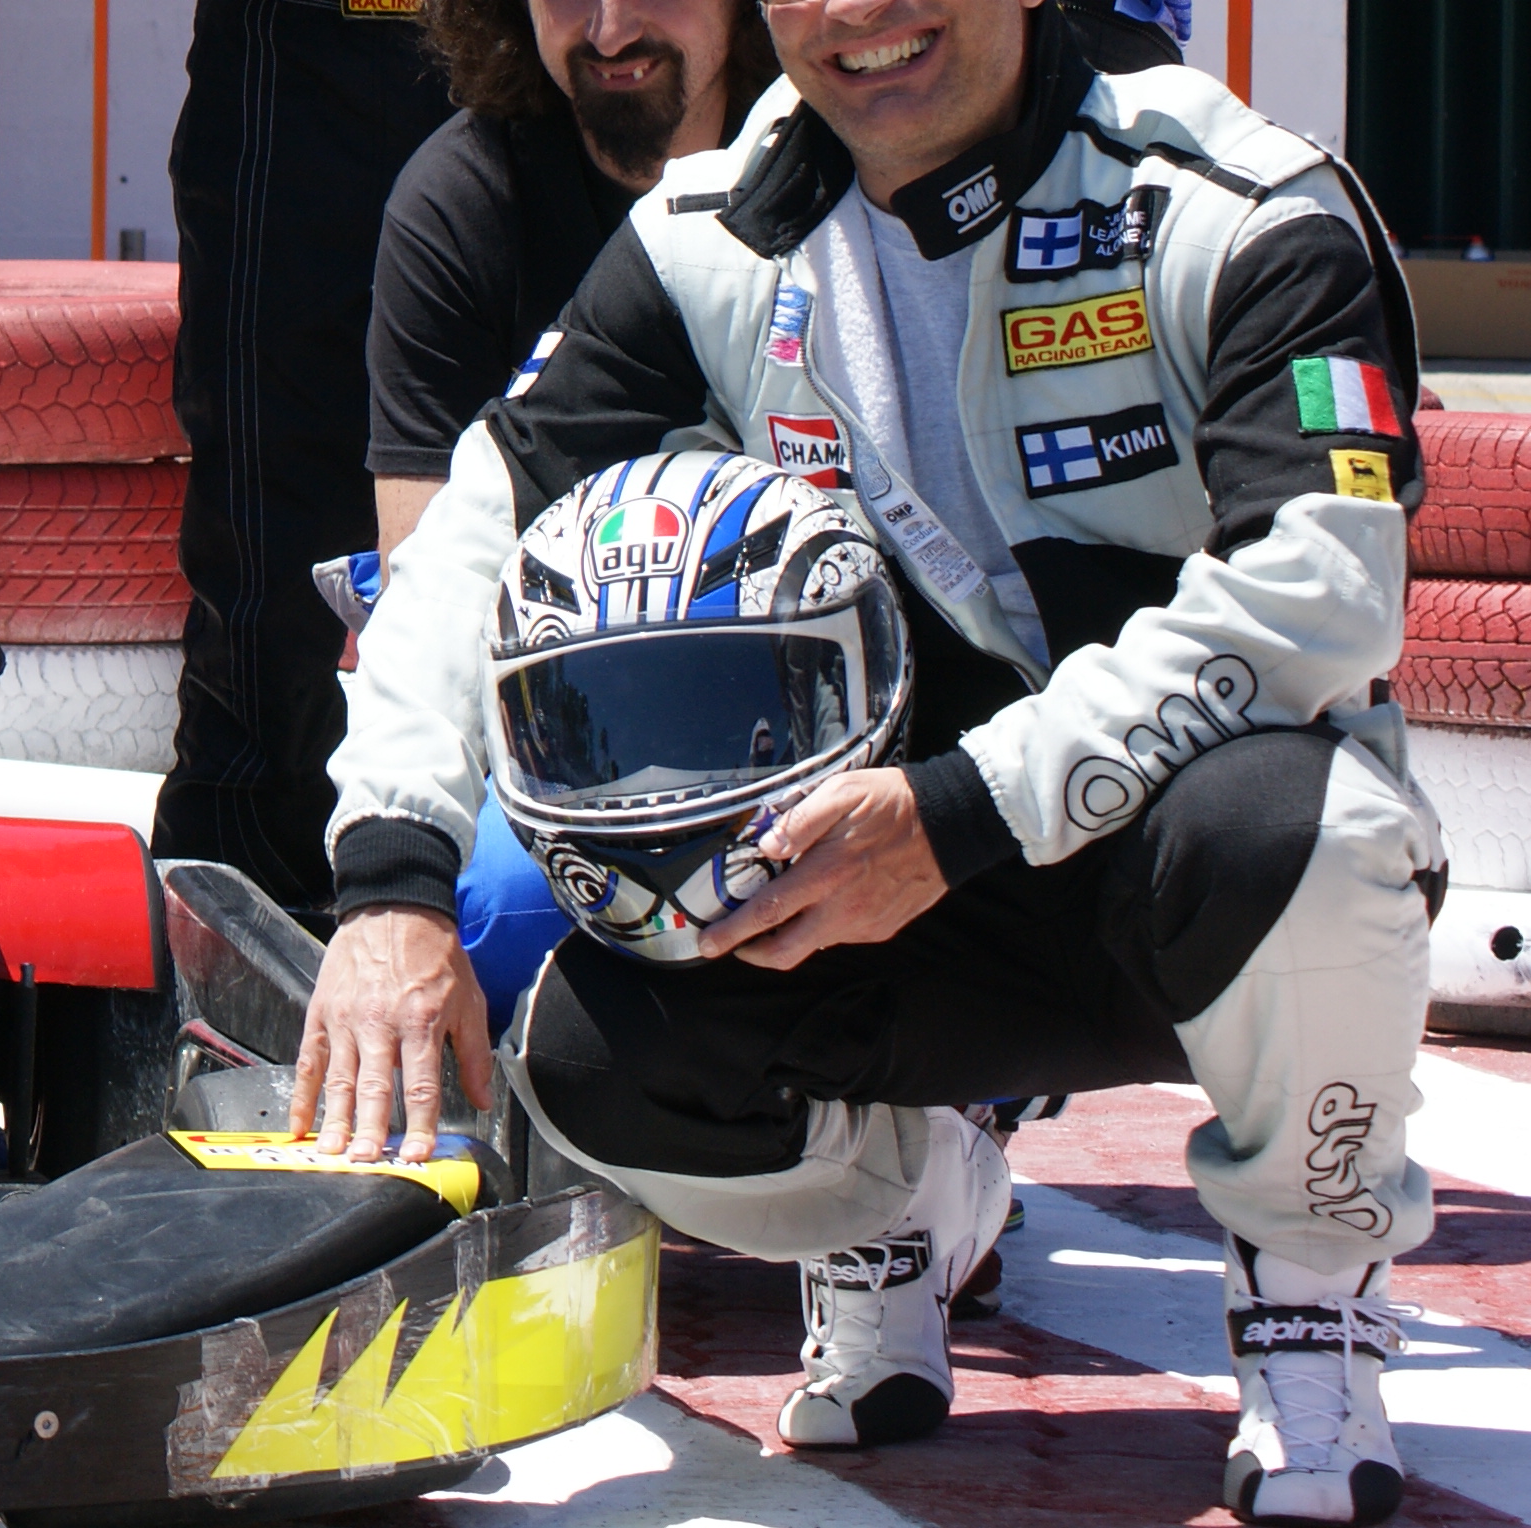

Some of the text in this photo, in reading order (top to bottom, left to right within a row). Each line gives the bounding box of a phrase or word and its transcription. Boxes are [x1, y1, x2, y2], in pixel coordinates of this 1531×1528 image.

[946, 174, 1000, 226] OMP
[1009, 301, 1146, 349] GAS
[1013, 332, 1150, 369] RACING TEAM
[1098, 423, 1169, 463] KIMI
[885, 503, 914, 524] OMP
[901, 521, 940, 550] Cordura
[601, 537, 677, 574] agv
[1064, 652, 1258, 832] OMP
